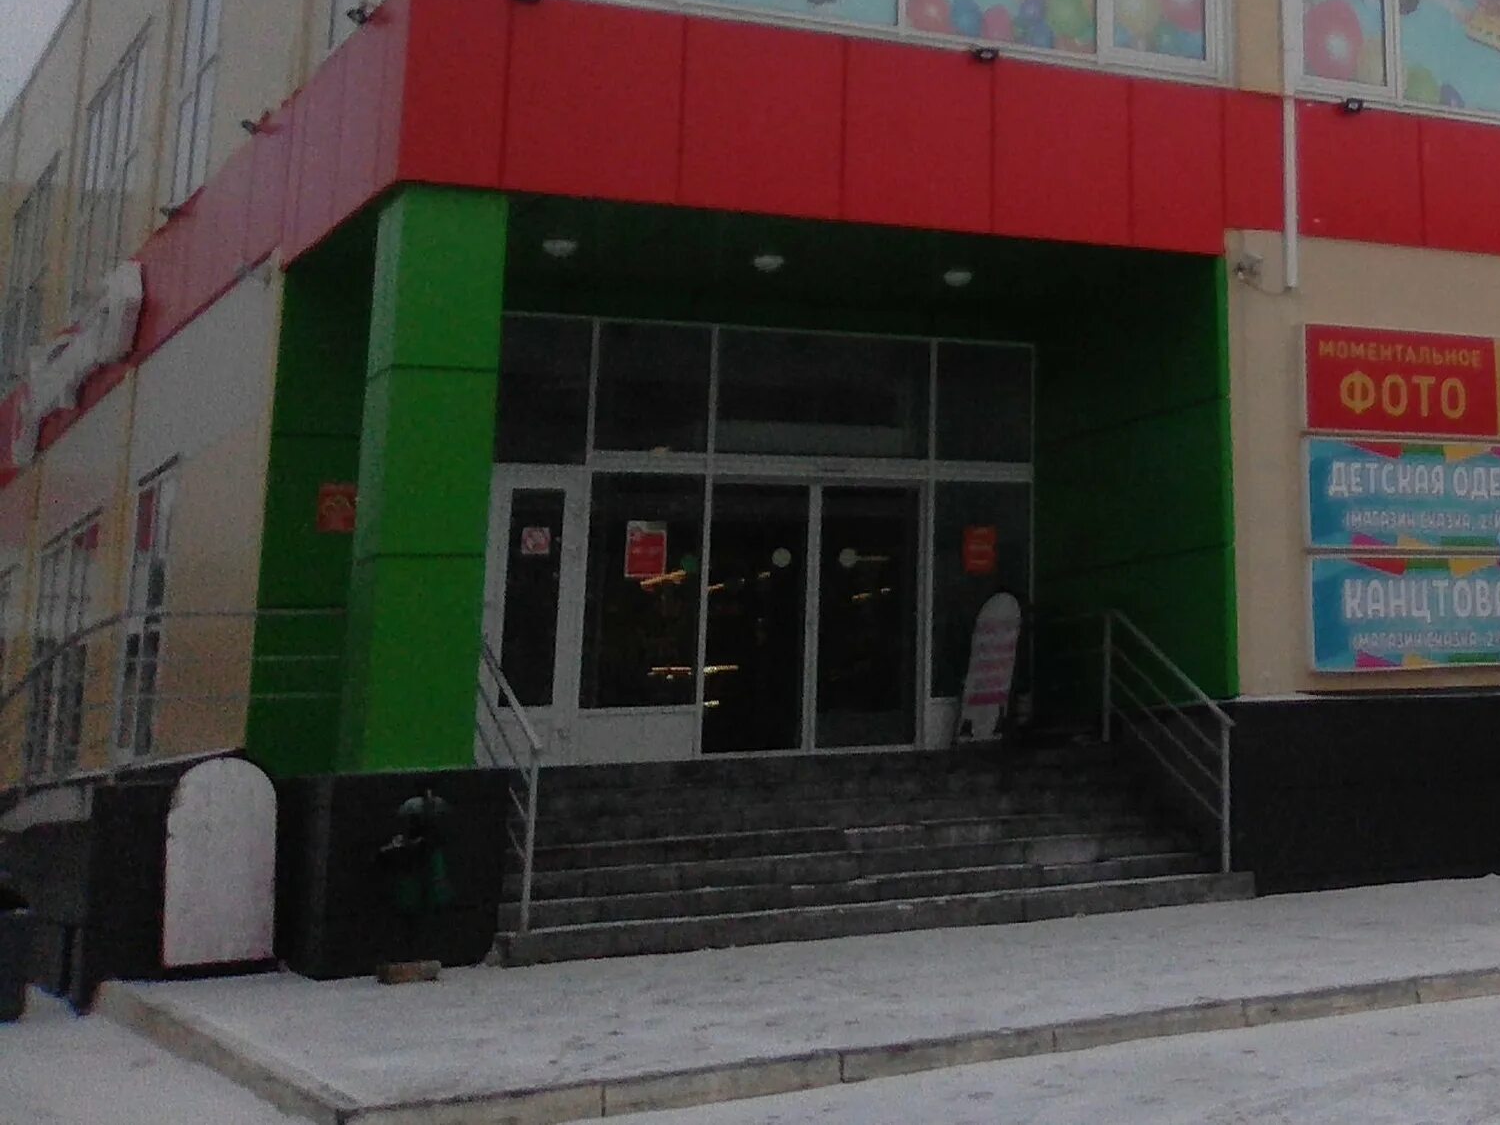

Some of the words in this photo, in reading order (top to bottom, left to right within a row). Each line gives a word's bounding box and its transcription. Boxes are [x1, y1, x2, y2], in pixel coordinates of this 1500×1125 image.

[1318, 338, 1483, 370] МОМЕНТАЛЬНОЕ
[1339, 370, 1467, 419] ФОТО
[1327, 460, 1444, 497] ДЕТСКАЯ
